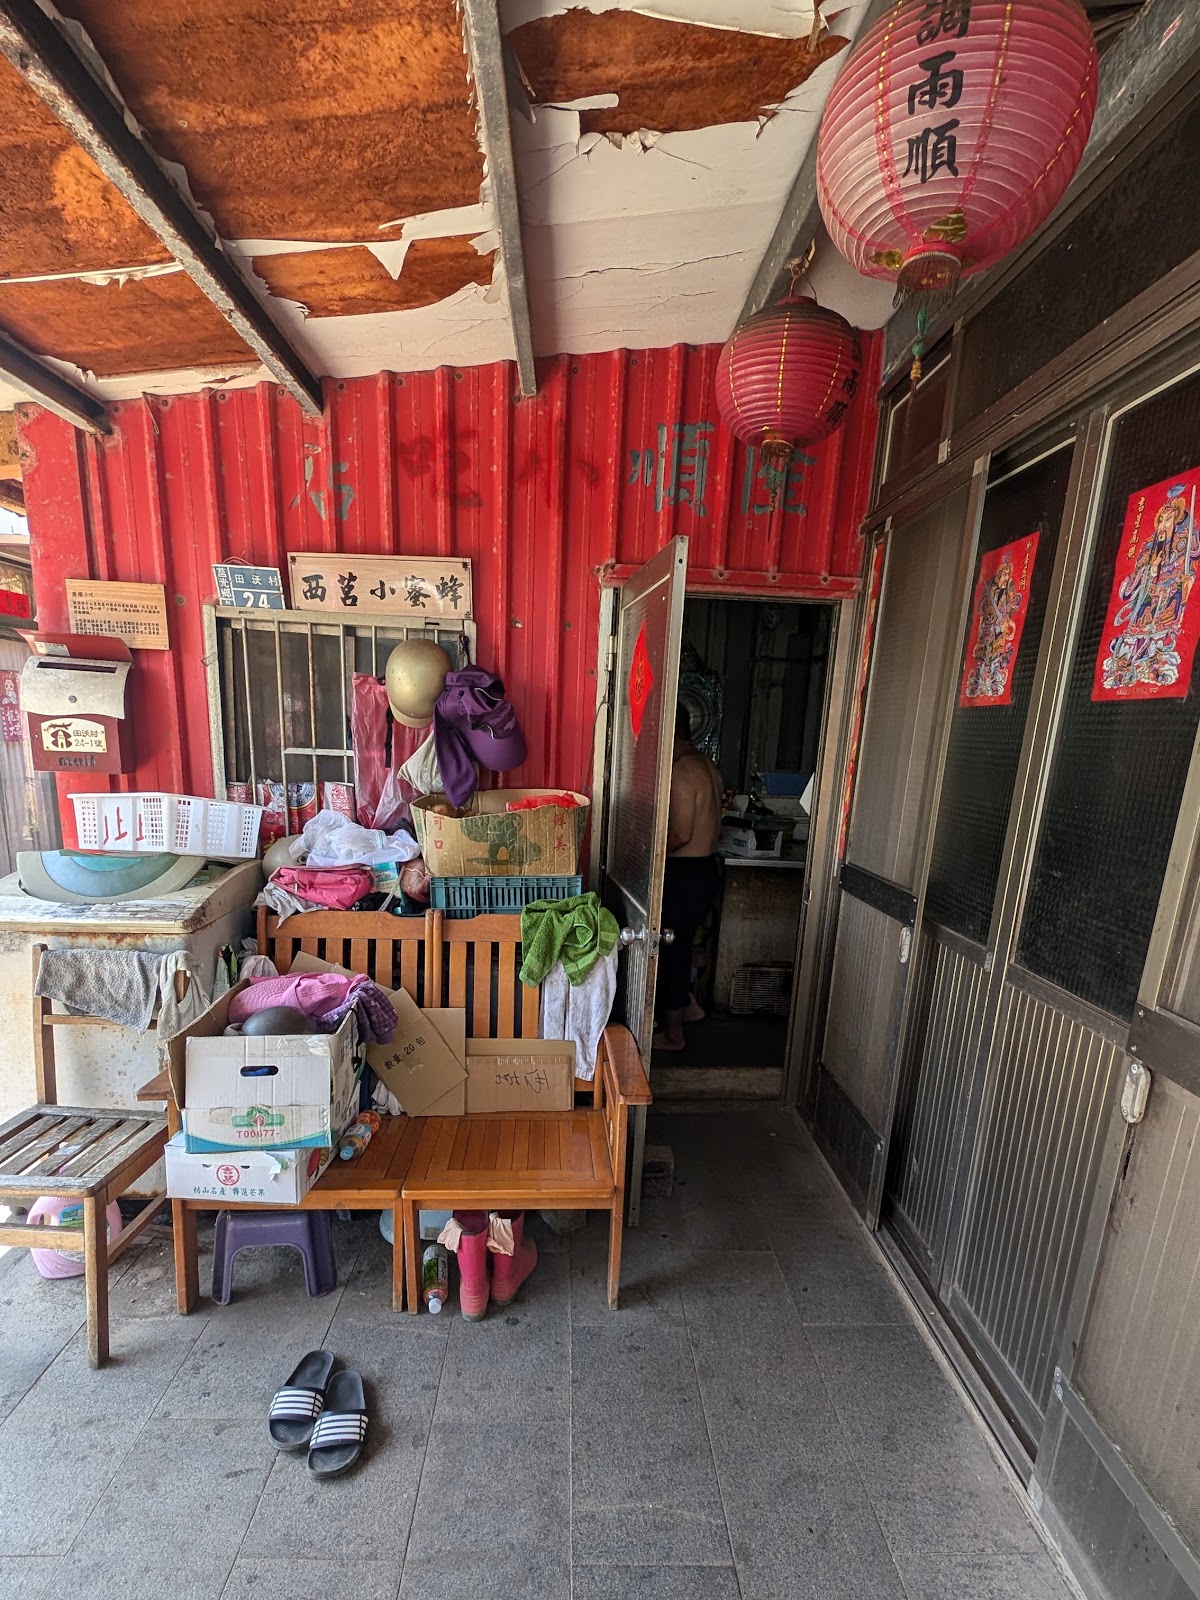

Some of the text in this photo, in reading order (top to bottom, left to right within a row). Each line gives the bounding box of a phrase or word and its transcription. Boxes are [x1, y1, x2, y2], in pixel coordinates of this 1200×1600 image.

[216, 567, 232, 598] 莒光鄉
[234, 573, 278, 587] 田沃村
[301, 572, 464, 610] 西莒小蜜蜂
[243, 591, 270, 608] 24
[73, 729, 99, 738] 田沃村
[74, 739, 104, 748] 24-1號
[433, 815, 446, 850] 可口
[552, 812, 568, 851] 鮮美
[384, 1036, 426, 1070] 數量 20 包
[193, 1185, 227, 1196] 枋山名產
